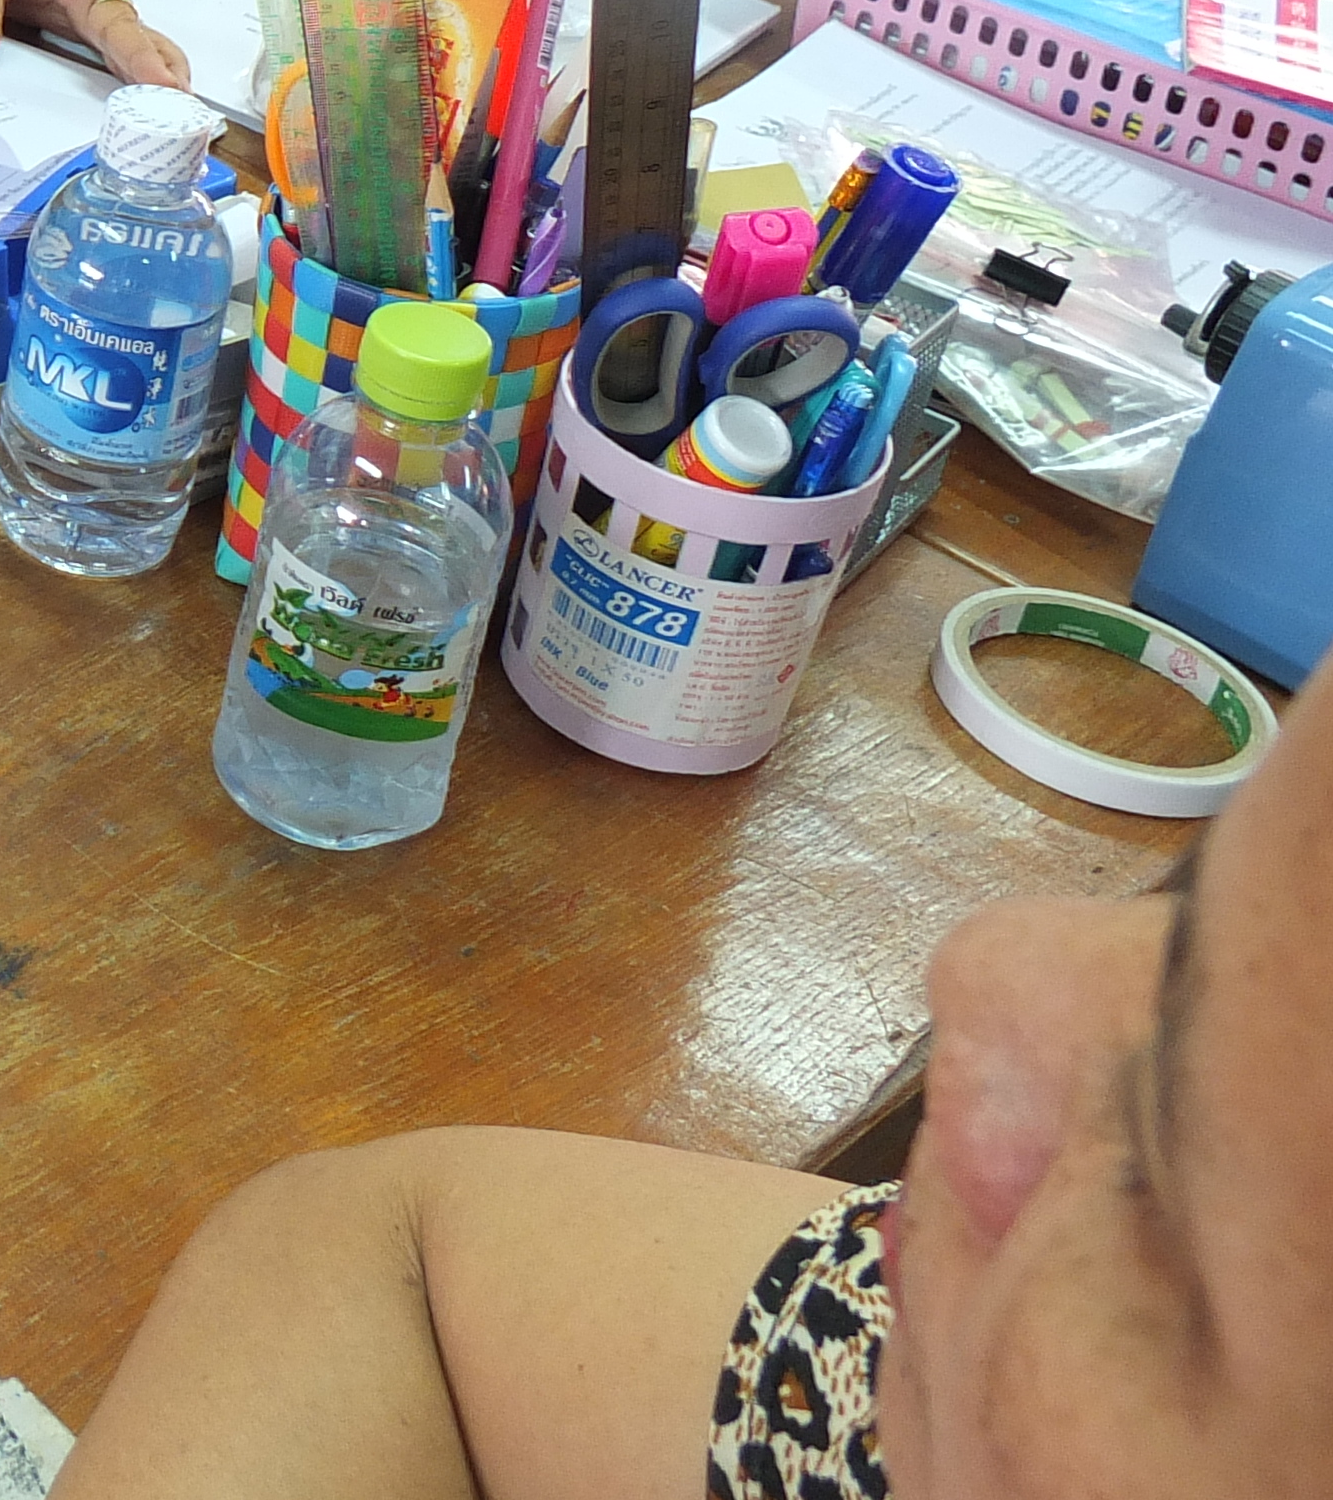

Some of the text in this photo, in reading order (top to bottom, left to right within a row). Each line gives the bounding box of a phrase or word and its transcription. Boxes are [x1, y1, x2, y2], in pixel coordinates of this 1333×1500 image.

[27, 334, 133, 412] MKL
[599, 552, 696, 602] LANCER
[606, 591, 687, 638] 878
[575, 666, 609, 691] Blue
